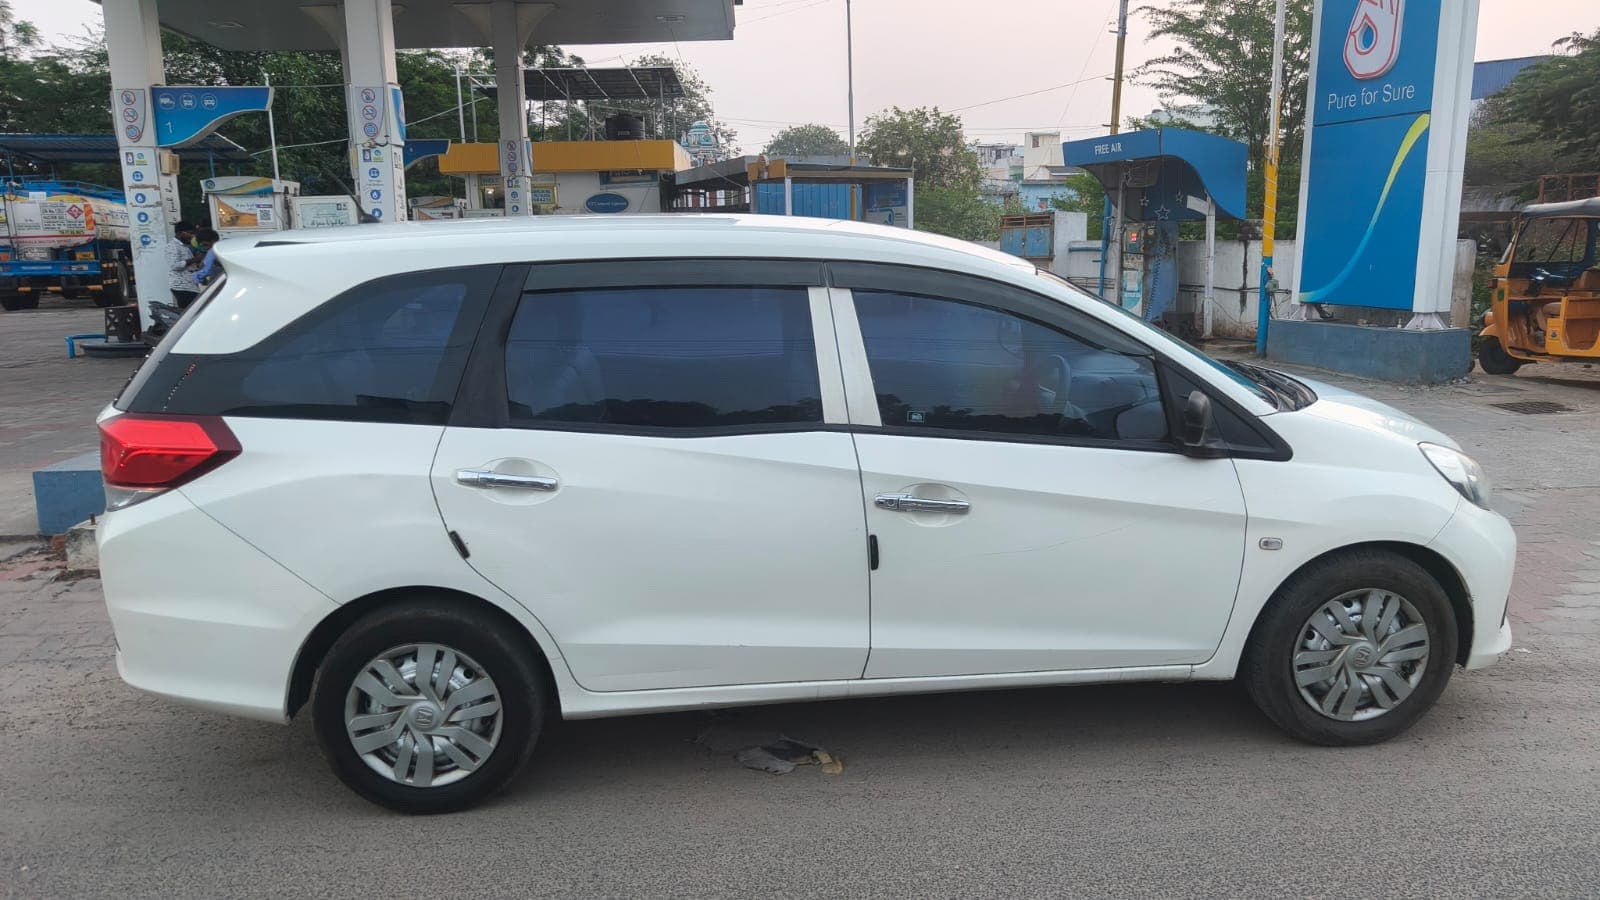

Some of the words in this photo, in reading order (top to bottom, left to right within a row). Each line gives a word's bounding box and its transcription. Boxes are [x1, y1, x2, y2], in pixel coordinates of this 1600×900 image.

[1327, 93, 1356, 111] Pure
[1361, 88, 1378, 105] for
[1383, 83, 1415, 102] Sure
[1094, 144, 1110, 155] FREE
[1110, 142, 1122, 153] AIR
